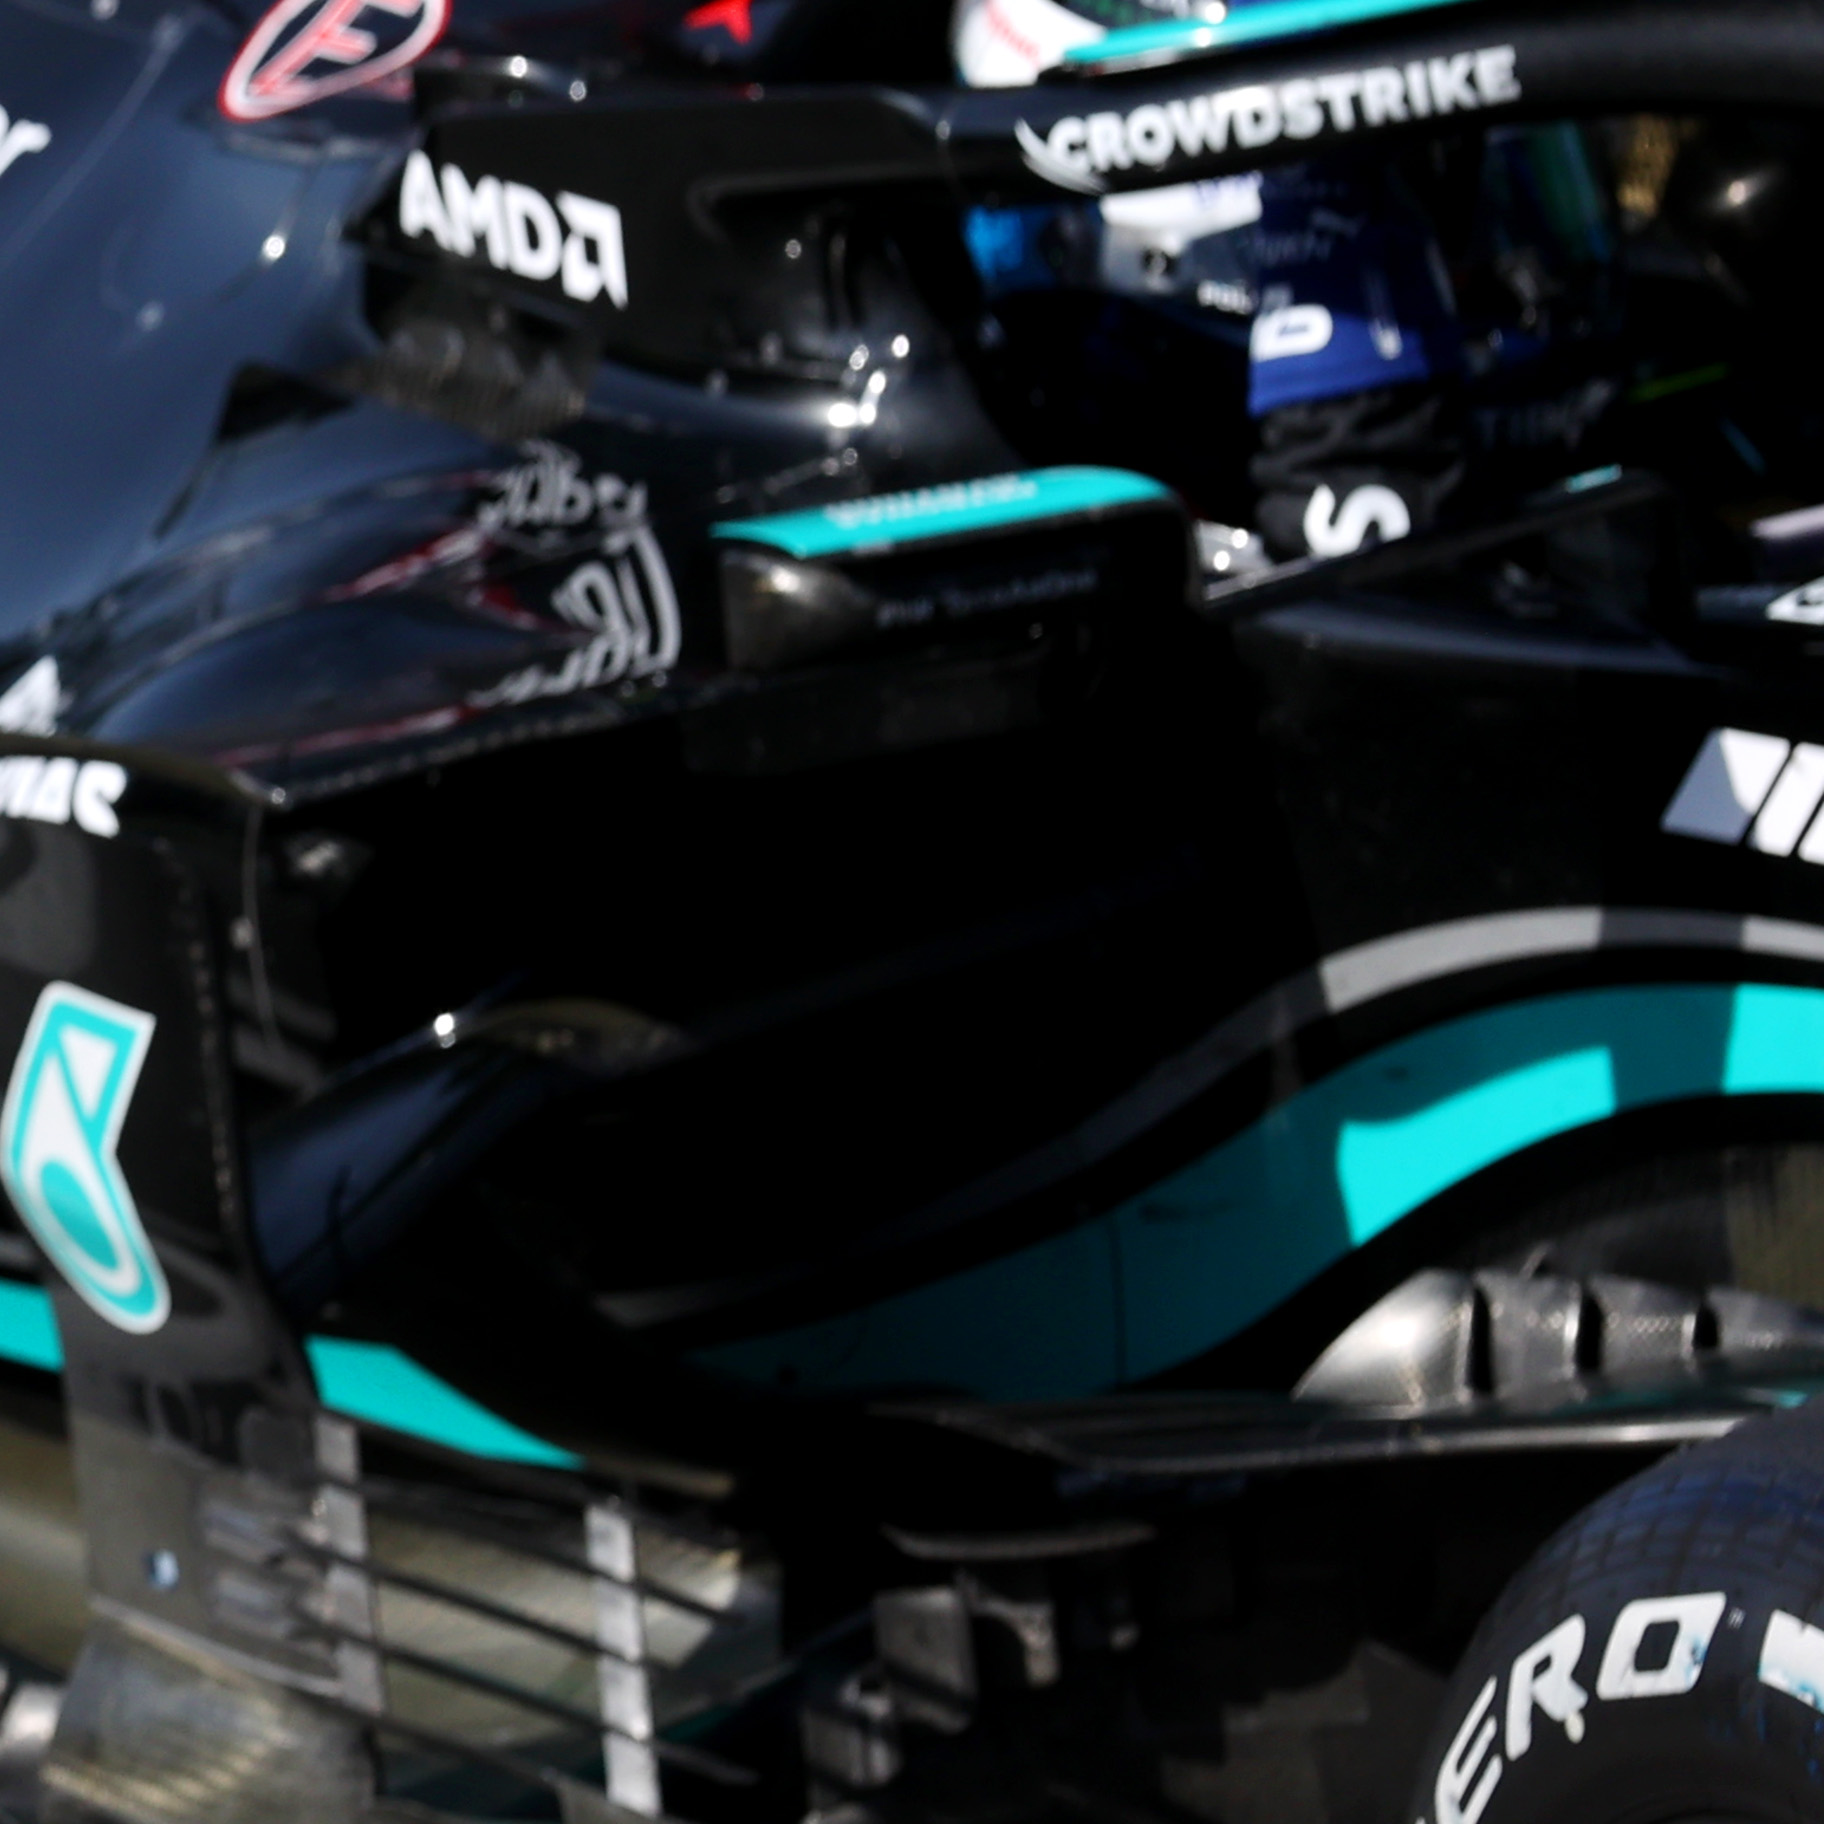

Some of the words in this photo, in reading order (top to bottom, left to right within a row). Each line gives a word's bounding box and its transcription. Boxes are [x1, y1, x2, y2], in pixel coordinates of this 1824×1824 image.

[1046, 45, 1520, 179] CROWDSTRIKE
[399, 149, 559, 282] AMD
[1415, 1590, 1728, 1824] ERO
